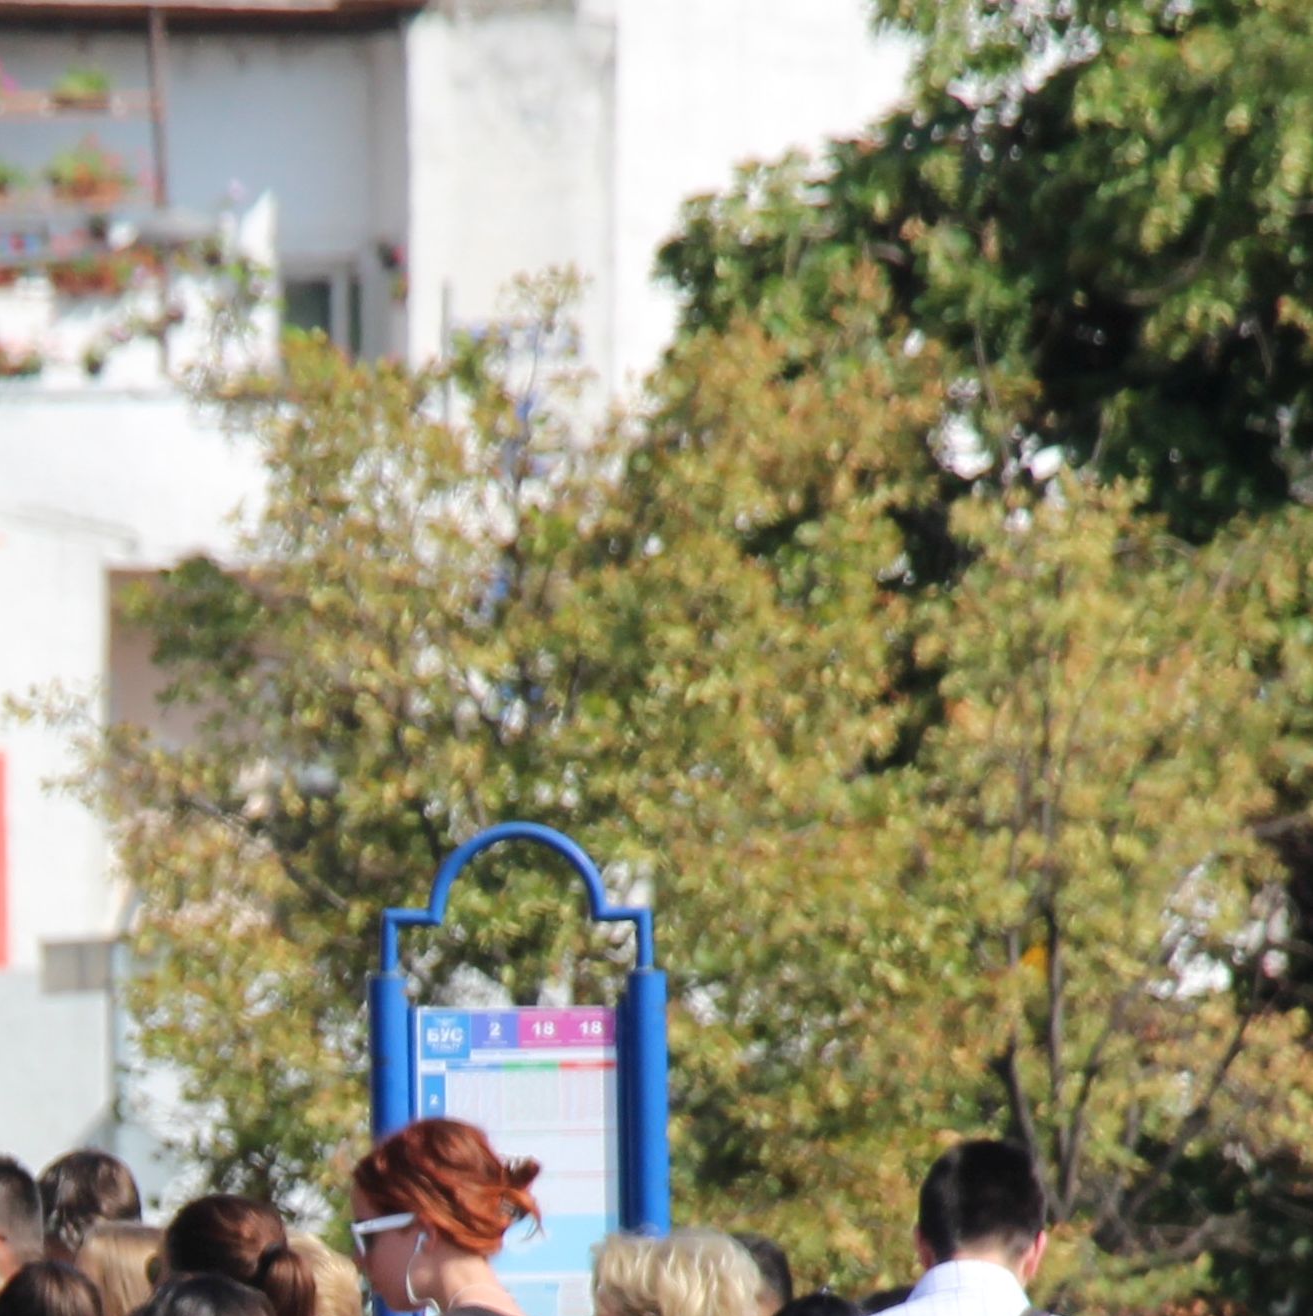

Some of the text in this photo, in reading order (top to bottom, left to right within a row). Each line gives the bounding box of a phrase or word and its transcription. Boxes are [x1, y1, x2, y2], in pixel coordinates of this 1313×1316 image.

[489, 1020, 603, 1037] 2 18 18
